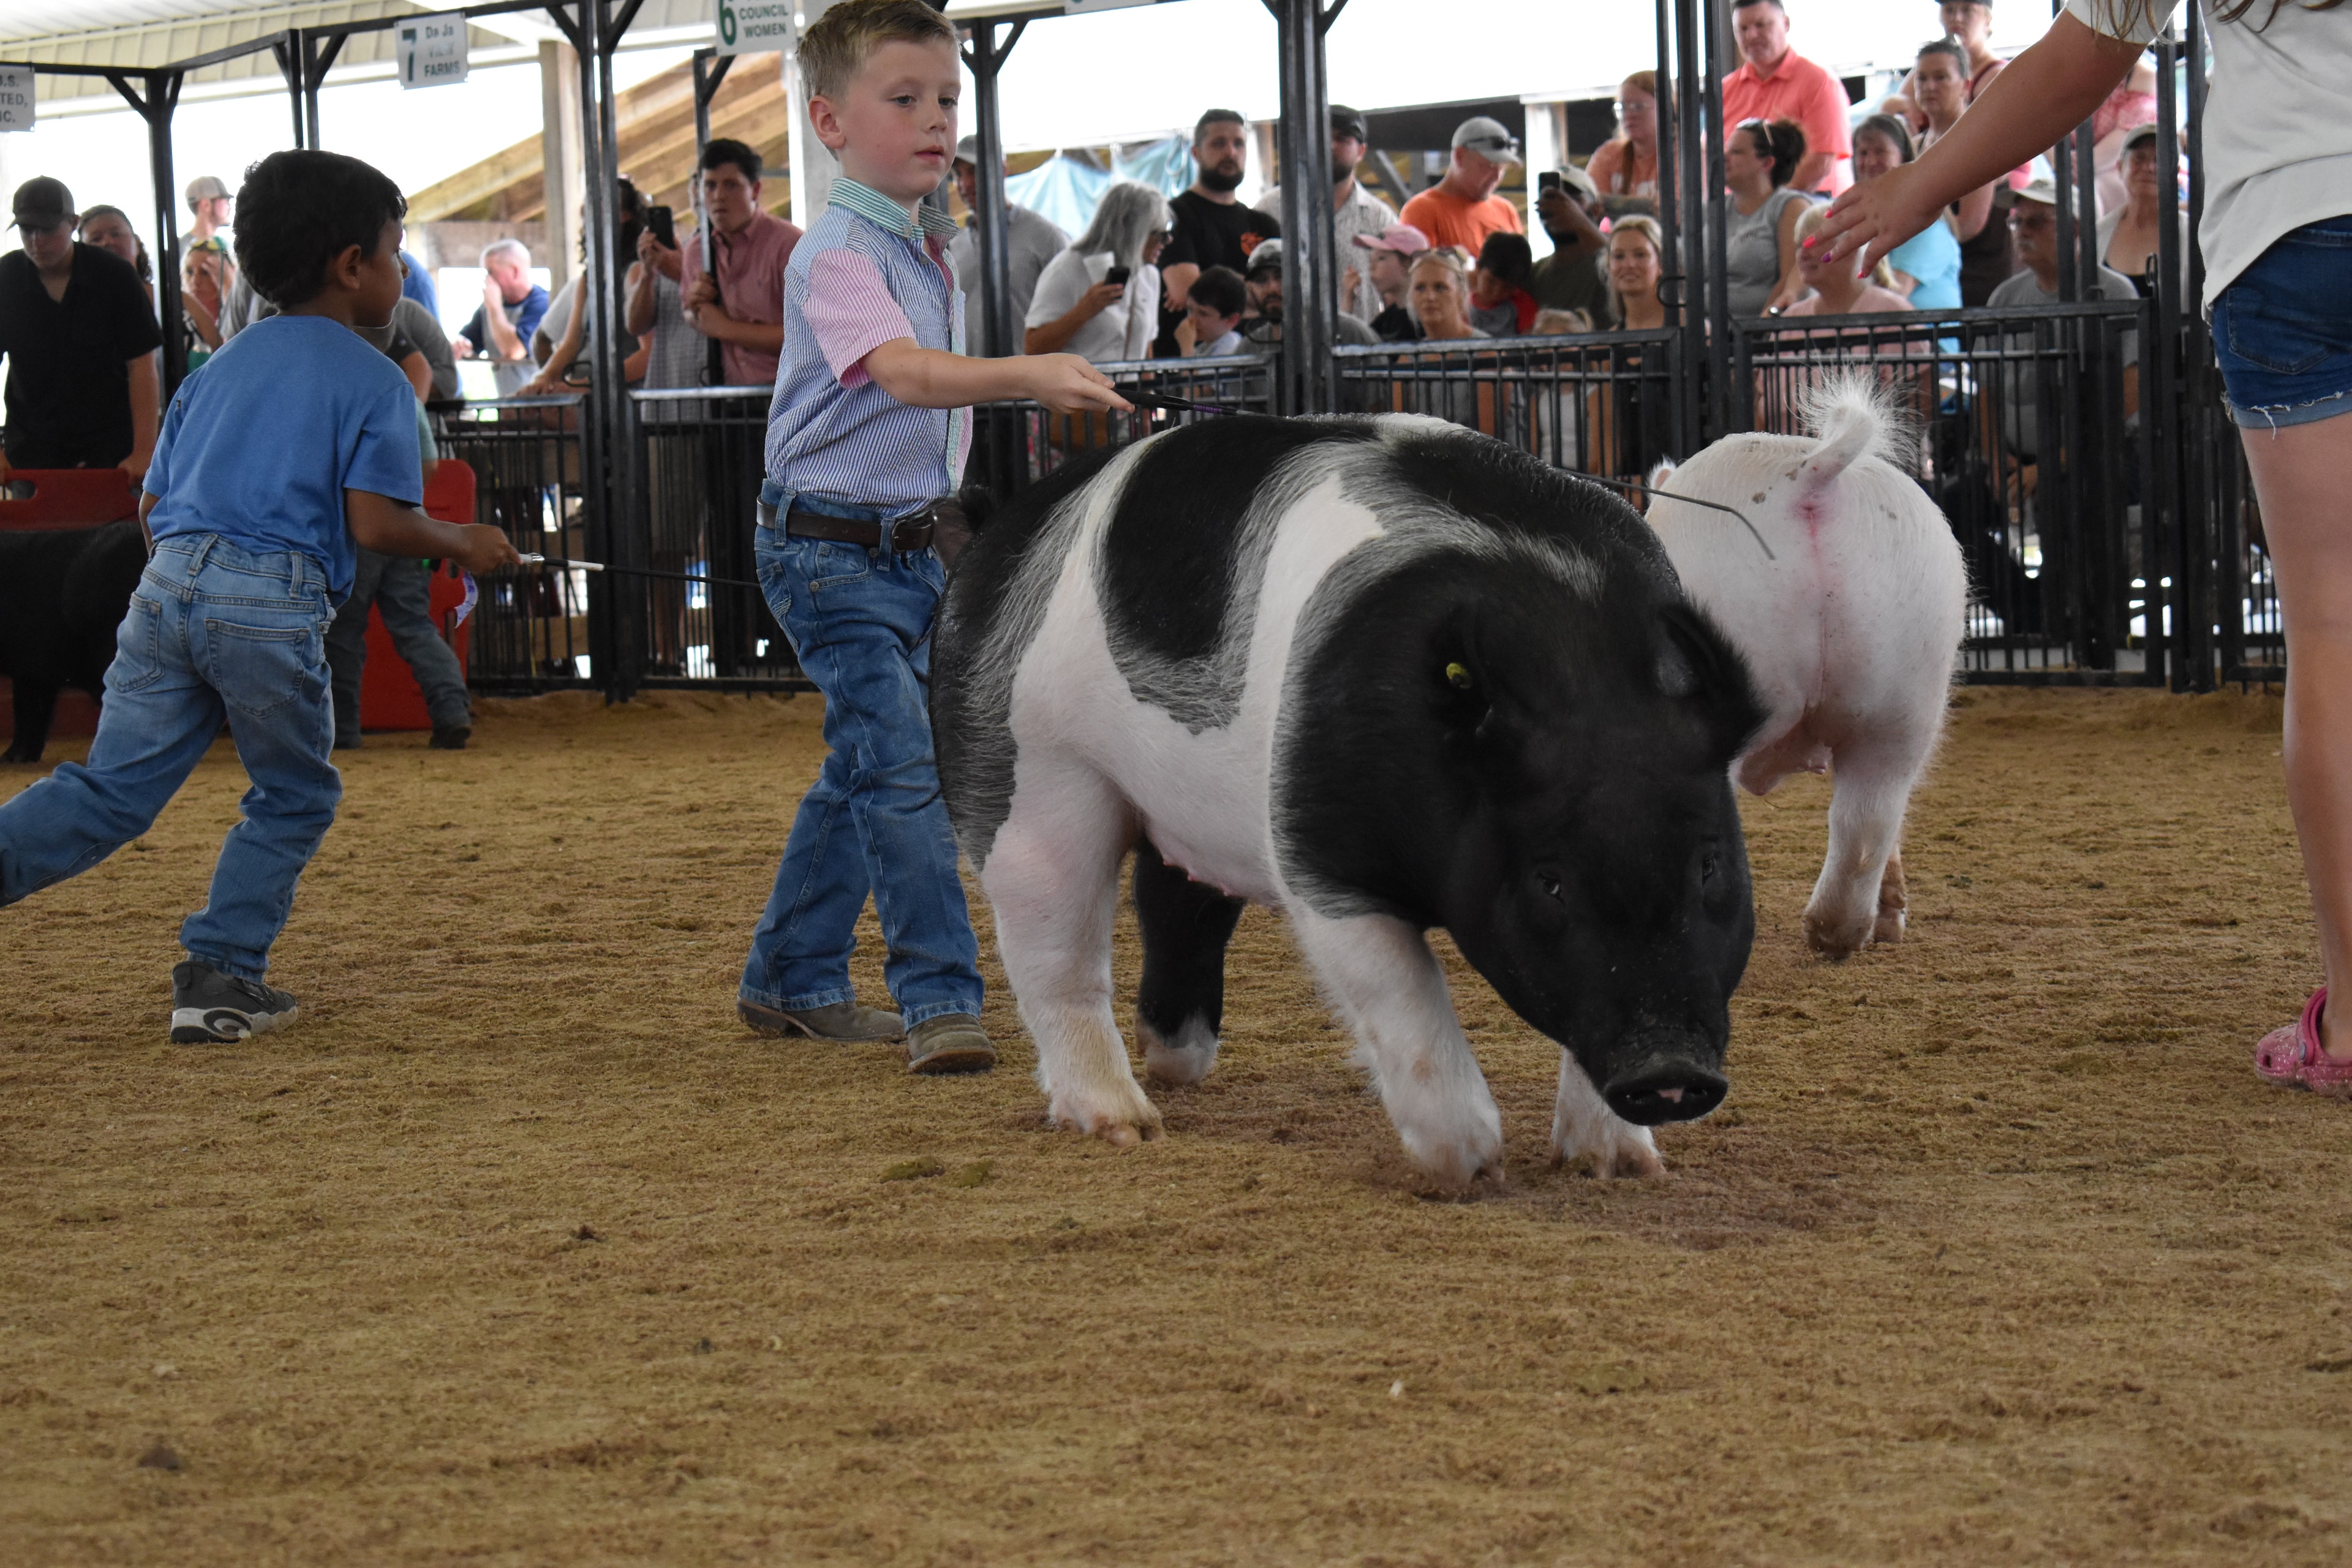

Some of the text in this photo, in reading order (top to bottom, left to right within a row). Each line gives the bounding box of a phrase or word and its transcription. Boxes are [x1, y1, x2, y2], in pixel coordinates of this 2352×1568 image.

[739, 4, 788, 20] COUNCIL
[719, 0, 737, 46] 6
[744, 22, 786, 38] WOMEN
[402, 28, 417, 82] 7
[424, 60, 461, 77] FARMS
